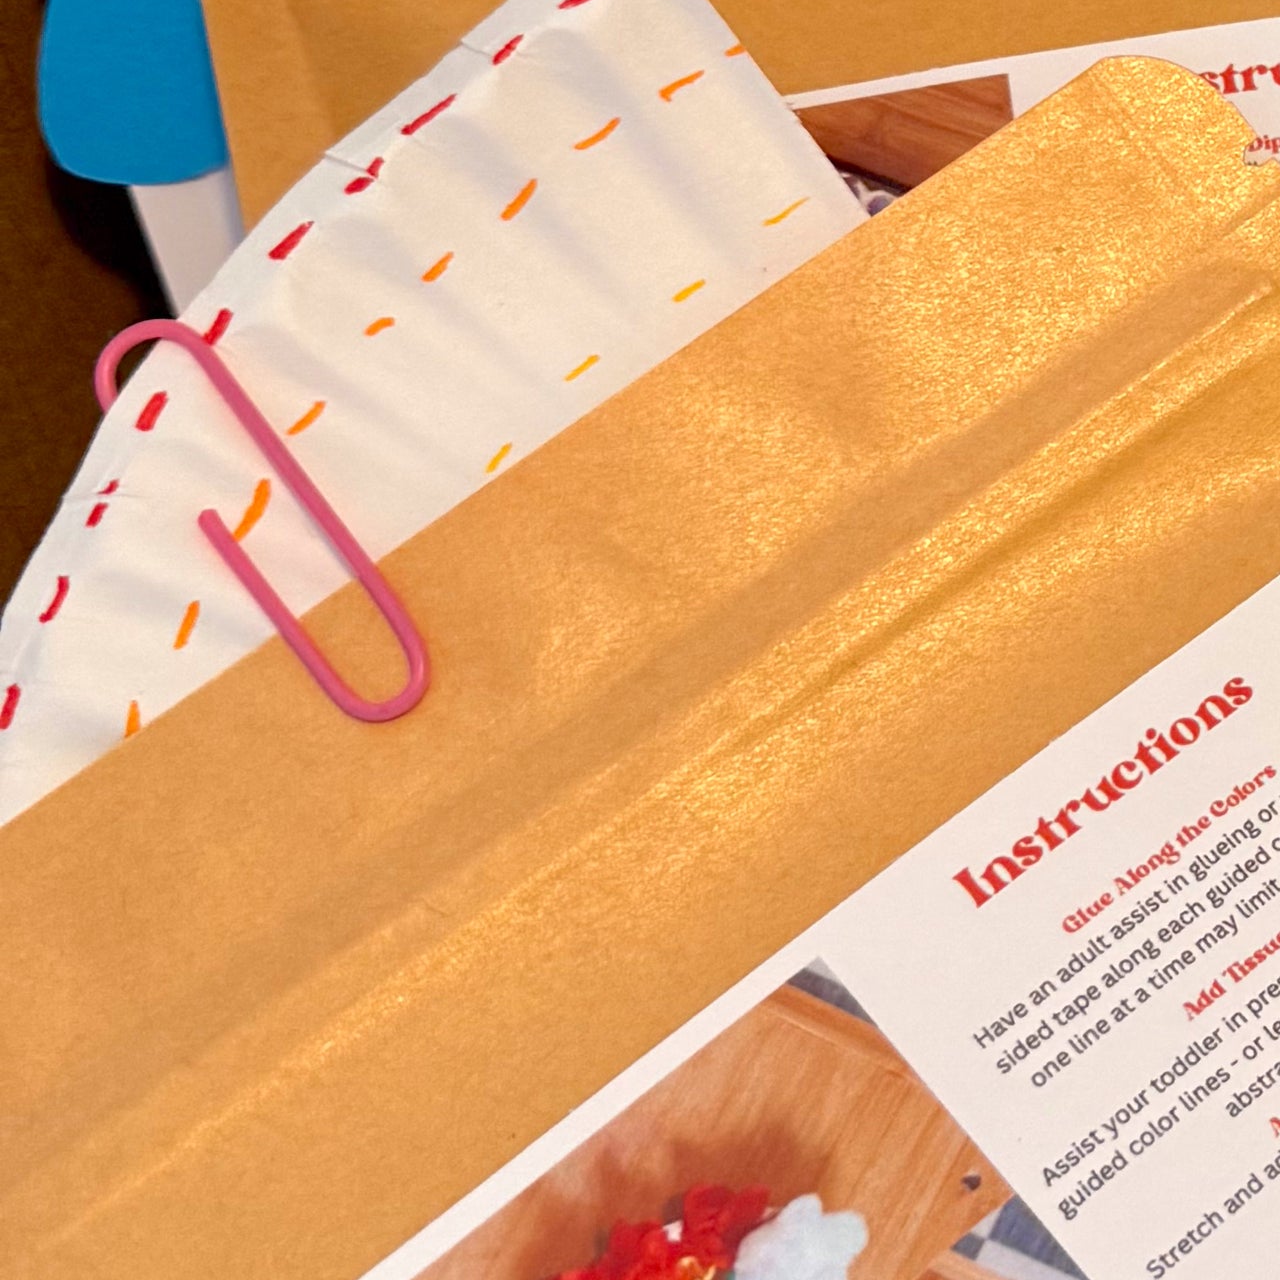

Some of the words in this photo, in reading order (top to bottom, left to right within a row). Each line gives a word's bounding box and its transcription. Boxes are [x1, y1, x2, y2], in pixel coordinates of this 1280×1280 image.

[951, 676, 1253, 908] Instructions
[1061, 891, 1114, 934] Glue
[1113, 841, 1181, 897] Along
[1175, 815, 1212, 848] the
[1208, 764, 1277, 818] Colors
[972, 1002, 1029, 1050] Have
[1028, 979, 1058, 1006] an
[1055, 934, 1113, 984] adult
[1109, 889, 1170, 941] assist
[1162, 874, 1190, 895] in
[1188, 818, 1262, 882] glueing
[1256, 800, 1279, 824] or
[995, 1018, 1055, 1075] sided
[1051, 984, 1102, 1027] tape
[1100, 938, 1162, 989] along
[1156, 901, 1207, 943] each
[1205, 845, 1272, 909] guided
[1182, 978, 1227, 1021] Add
[1145, 1210, 1225, 1280] Stretch
[1222, 1172, 1265, 1215] and
